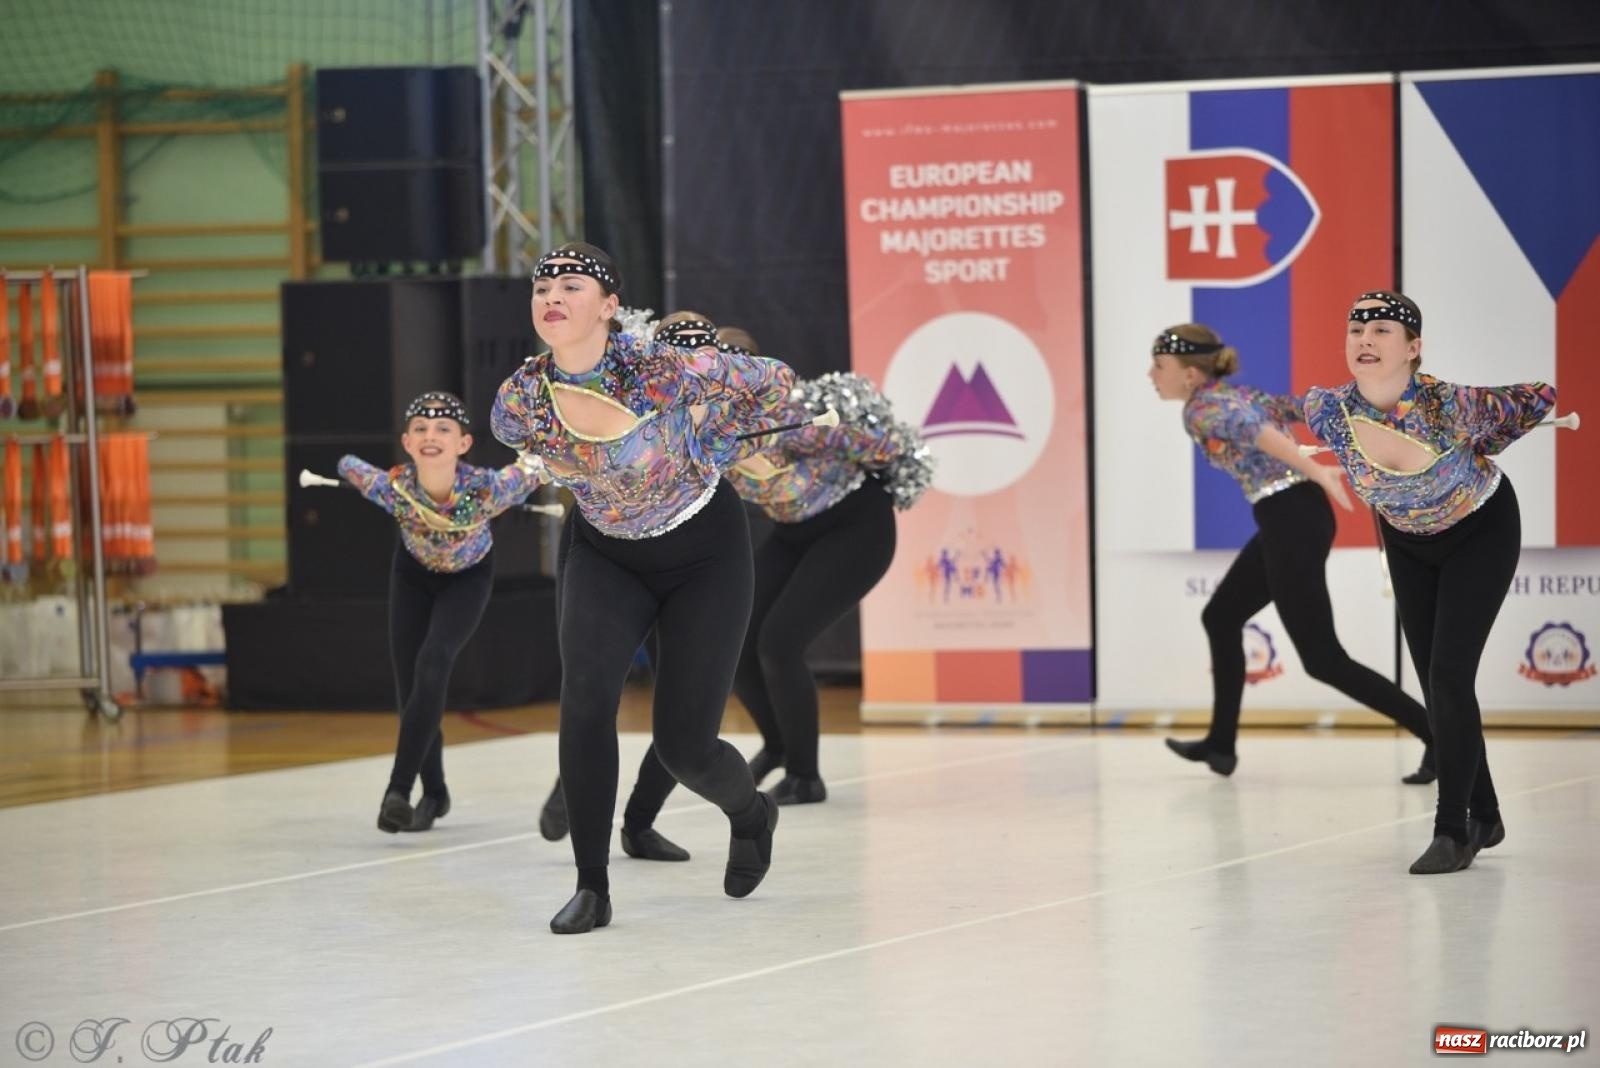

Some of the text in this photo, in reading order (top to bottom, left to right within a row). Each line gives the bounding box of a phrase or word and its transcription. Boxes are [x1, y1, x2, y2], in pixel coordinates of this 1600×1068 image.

[889, 159, 1033, 188] EUROPEAN
[860, 190, 1064, 222] CHAMPIONSHIP
[880, 223, 1046, 256] MAJORETTES
[925, 257, 1010, 284] SPORT
